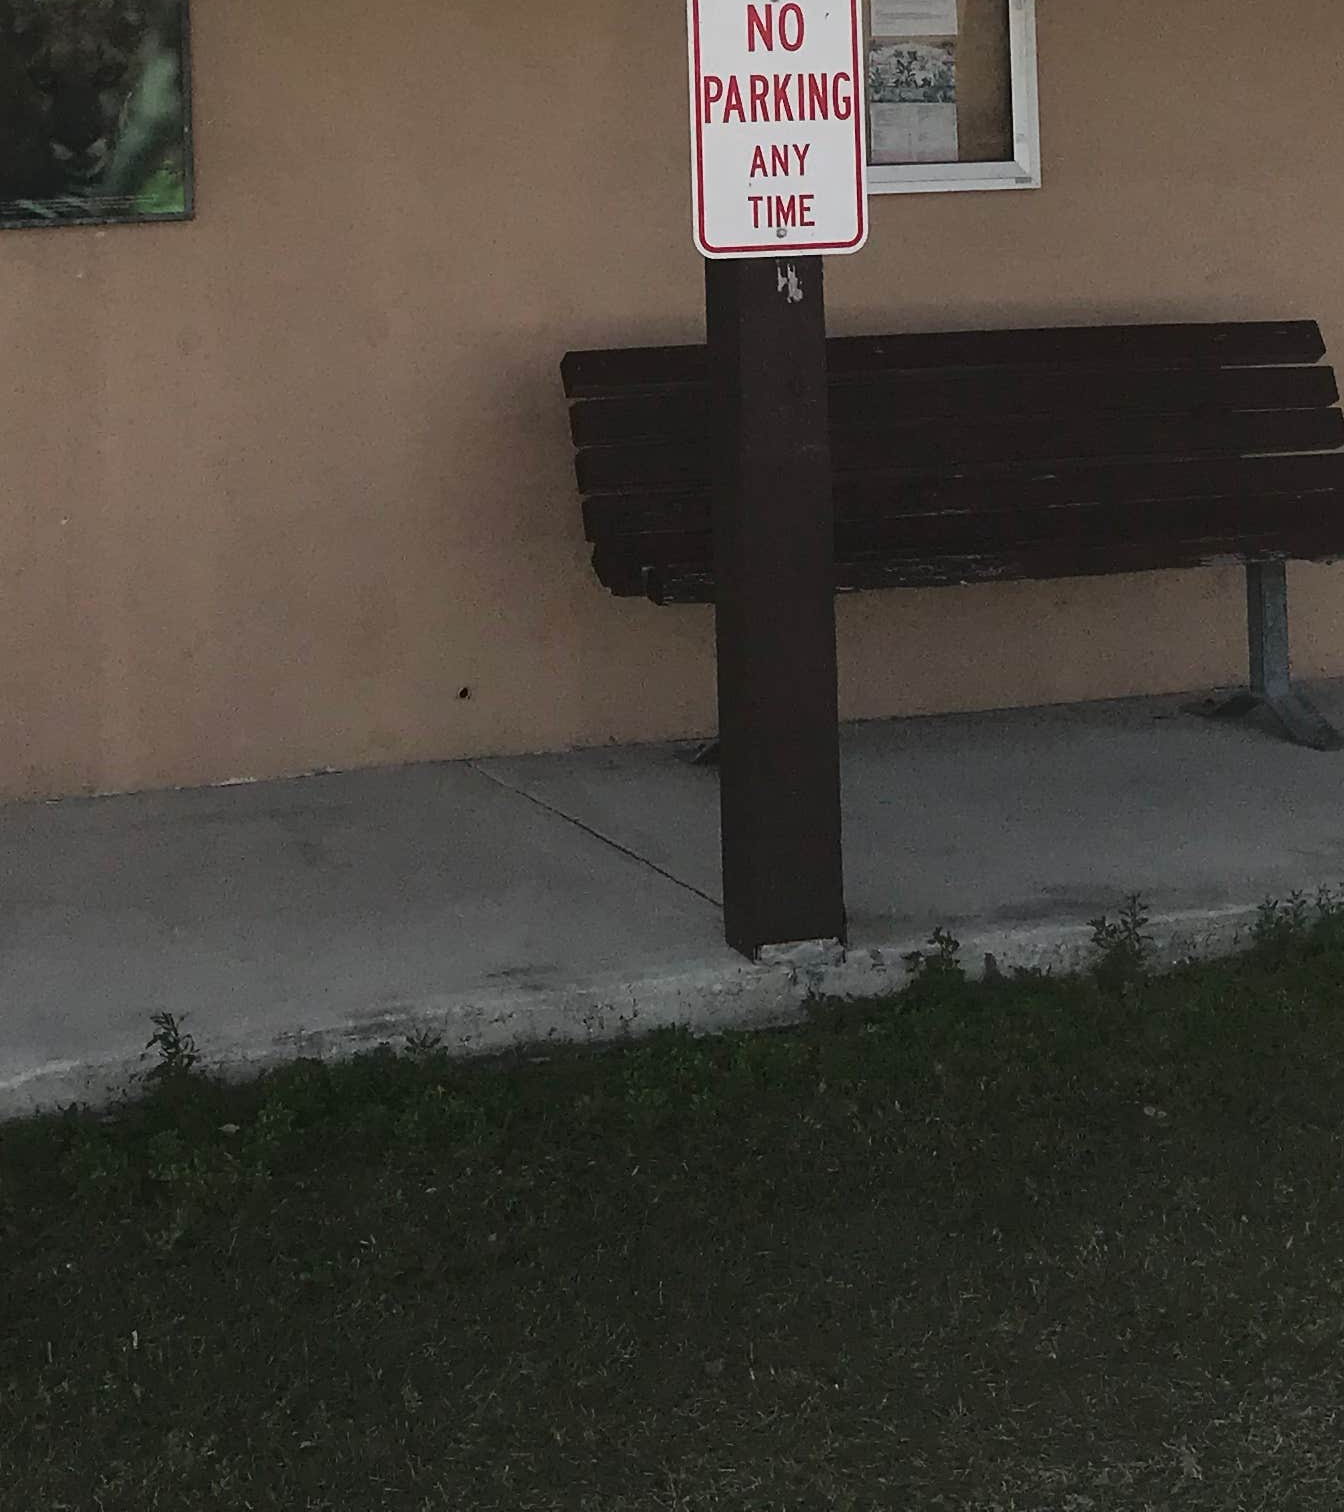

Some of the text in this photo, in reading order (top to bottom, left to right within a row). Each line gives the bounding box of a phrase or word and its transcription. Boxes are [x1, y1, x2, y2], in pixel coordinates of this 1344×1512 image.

[746, 2, 805, 52] NO
[703, 71, 852, 124] PARKING
[749, 143, 811, 178] ANY
[747, 194, 816, 229] TIME
